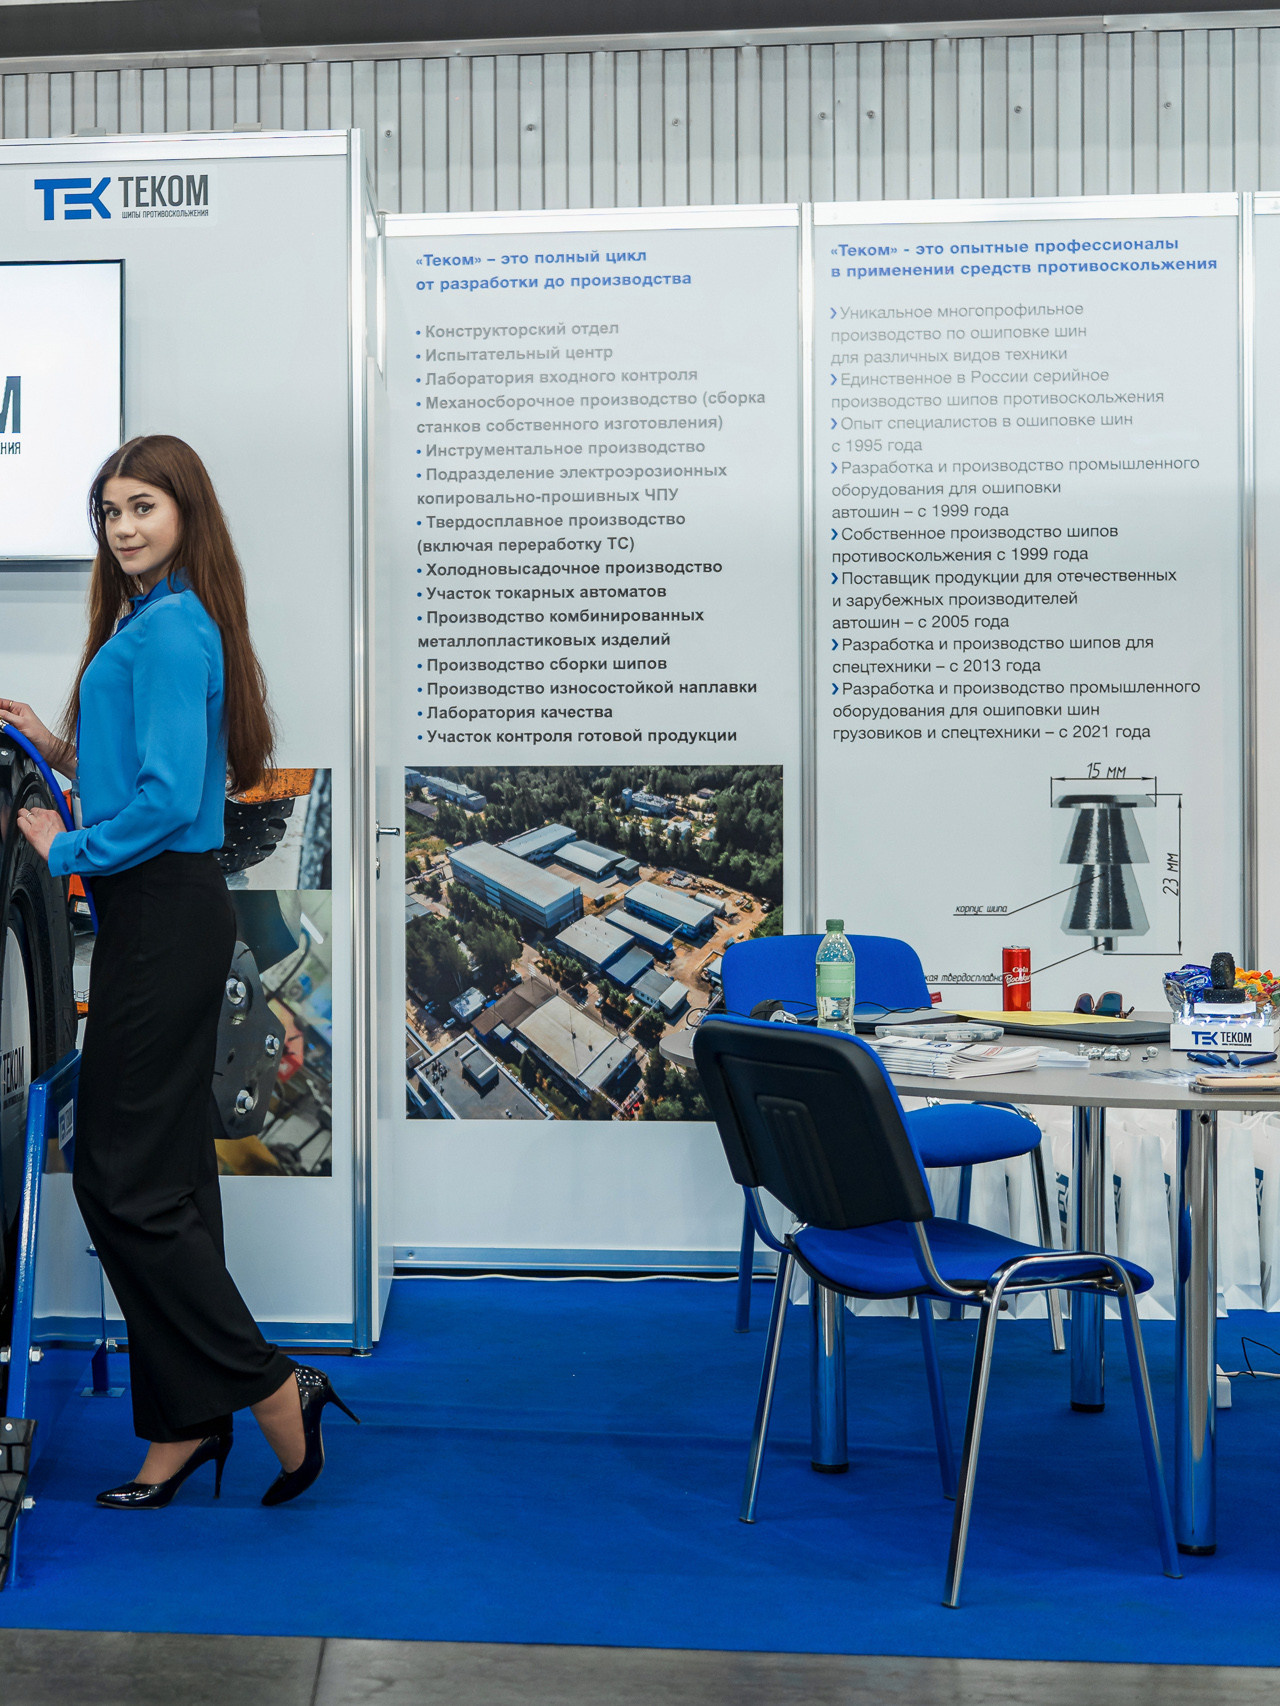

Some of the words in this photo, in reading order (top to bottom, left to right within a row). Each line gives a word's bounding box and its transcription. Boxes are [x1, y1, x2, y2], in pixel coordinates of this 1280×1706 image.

[118, 174, 208, 208] ТЕКОМ
[121, 210, 141, 219] ШИПЫ
[142, 209, 209, 218] ПРОТИВОСКОЛЬЖЕНИЯ
[830, 243, 898, 257] «Теком»
[915, 244, 945, 256] это
[949, 242, 1029, 255] опытные
[1034, 238, 1179, 255] профессионалы
[415, 253, 482, 267] «Теком»
[500, 254, 529, 265] это
[534, 249, 600, 264] полный
[605, 251, 647, 265] цикл
[831, 267, 841, 278] в
[846, 265, 955, 280] применении
[960, 263, 1032, 278] средств
[1037, 259, 1218, 276] противоскольжения
[415, 280, 435, 291] от
[439, 275, 539, 293] разработки
[543, 277, 565, 290] до
[570, 274, 692, 290] производства
[425, 443, 583, 460] Инструментальное
[588, 442, 706, 458] производство
[425, 467, 555, 484] Подразделение
[559, 466, 728, 482] электроэрозионных
[416, 491, 640, 508] копировально-прошивных
[644, 487, 679, 502] ЧПУ
[425, 515, 564, 532] Твердосплавное
[568, 514, 686, 530] производство
[841, 527, 946, 541] Собственное
[950, 527, 1062, 543] производство
[1066, 526, 1119, 538] шипов
[417, 539, 493, 557] (включая
[498, 536, 603, 555] переработку
[606, 536, 635, 554] ТС)
[832, 550, 992, 566] противоскольжения
[996, 550, 1006, 561] с
[1011, 546, 1049, 561] 1999
[1053, 549, 1089, 563] года
[425, 562, 601, 579] Холодновысадочное
[605, 562, 723, 577] производство
[842, 571, 931, 587] Поставщик
[935, 572, 1019, 587] продукции
[1023, 572, 1052, 586] для
[1056, 570, 1177, 583] отечественных
[425, 586, 492, 600] Участок
[494, 588, 575, 602] токарных
[579, 587, 667, 599] автоматов
[832, 597, 842, 607] и
[846, 593, 944, 610] зарубежных
[948, 590, 1078, 609] производителей
[426, 610, 545, 627] Производство
[549, 608, 705, 625] комбинированных
[417, 635, 597, 648] металлопластиковых
[601, 632, 671, 648] изделий
[427, 658, 545, 675] Производство
[549, 656, 608, 674] сборки
[612, 659, 668, 670] шипов
[427, 682, 545, 699] Производство
[549, 680, 674, 695] износостойкой
[679, 683, 757, 694] наплавки
[841, 681, 935, 699] Разработка
[939, 684, 948, 695] и
[953, 683, 1065, 698] производство
[1069, 682, 1201, 697] промышленного
[426, 705, 536, 722] Лаборатория
[540, 707, 613, 719] качества
[832, 704, 945, 721] оборудования
[949, 706, 978, 720] для
[982, 705, 1062, 717] ошиповки
[1067, 705, 1100, 716] шин
[426, 729, 492, 743] Участок
[496, 732, 573, 746] контроля
[577, 728, 643, 743] готовой
[647, 731, 737, 745] продукции
[833, 728, 923, 743] грузовиков
[927, 728, 937, 739] и
[940, 728, 1041, 742] спецтехники
[1058, 727, 1068, 739] с
[1072, 724, 1108, 739] 2021
[1115, 727, 1151, 741] года
[1087, 762, 1101, 779] 15
[1162, 877, 1179, 897] 23
[955, 905, 984, 915] корпус
[986, 905, 1008, 913] шипа
[1220, 1031, 1252, 1043] ТЕКОМ
